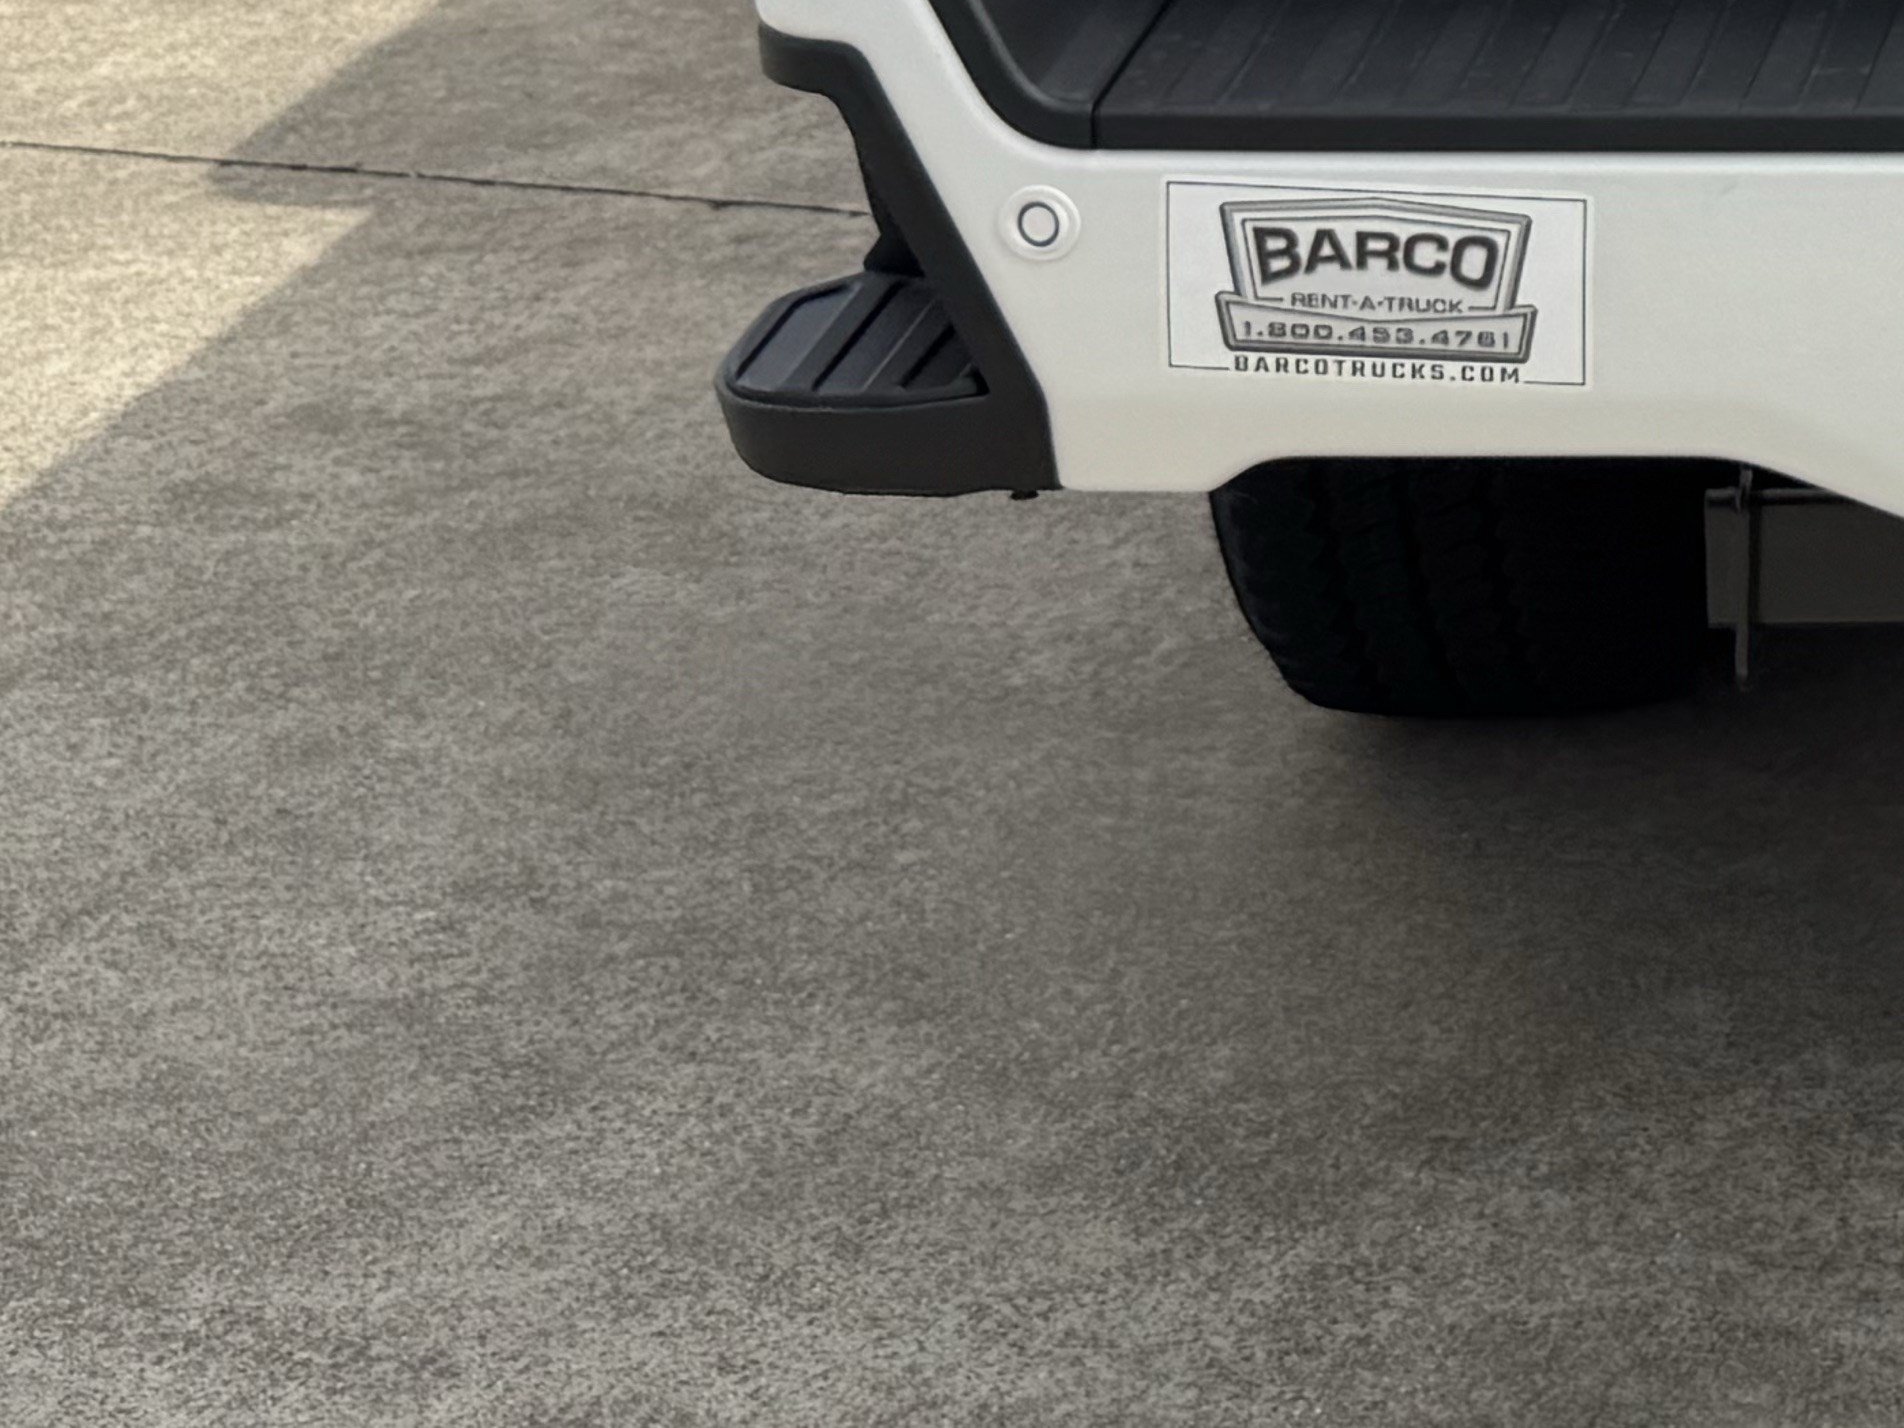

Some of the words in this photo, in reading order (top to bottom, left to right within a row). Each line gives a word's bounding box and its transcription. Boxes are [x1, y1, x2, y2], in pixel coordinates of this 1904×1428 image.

[1252, 225, 1500, 291] BARCO
[1290, 291, 1464, 314] RENT-A-TRUCK
[1233, 354, 1521, 384] BARCOTRUCKS.COM
